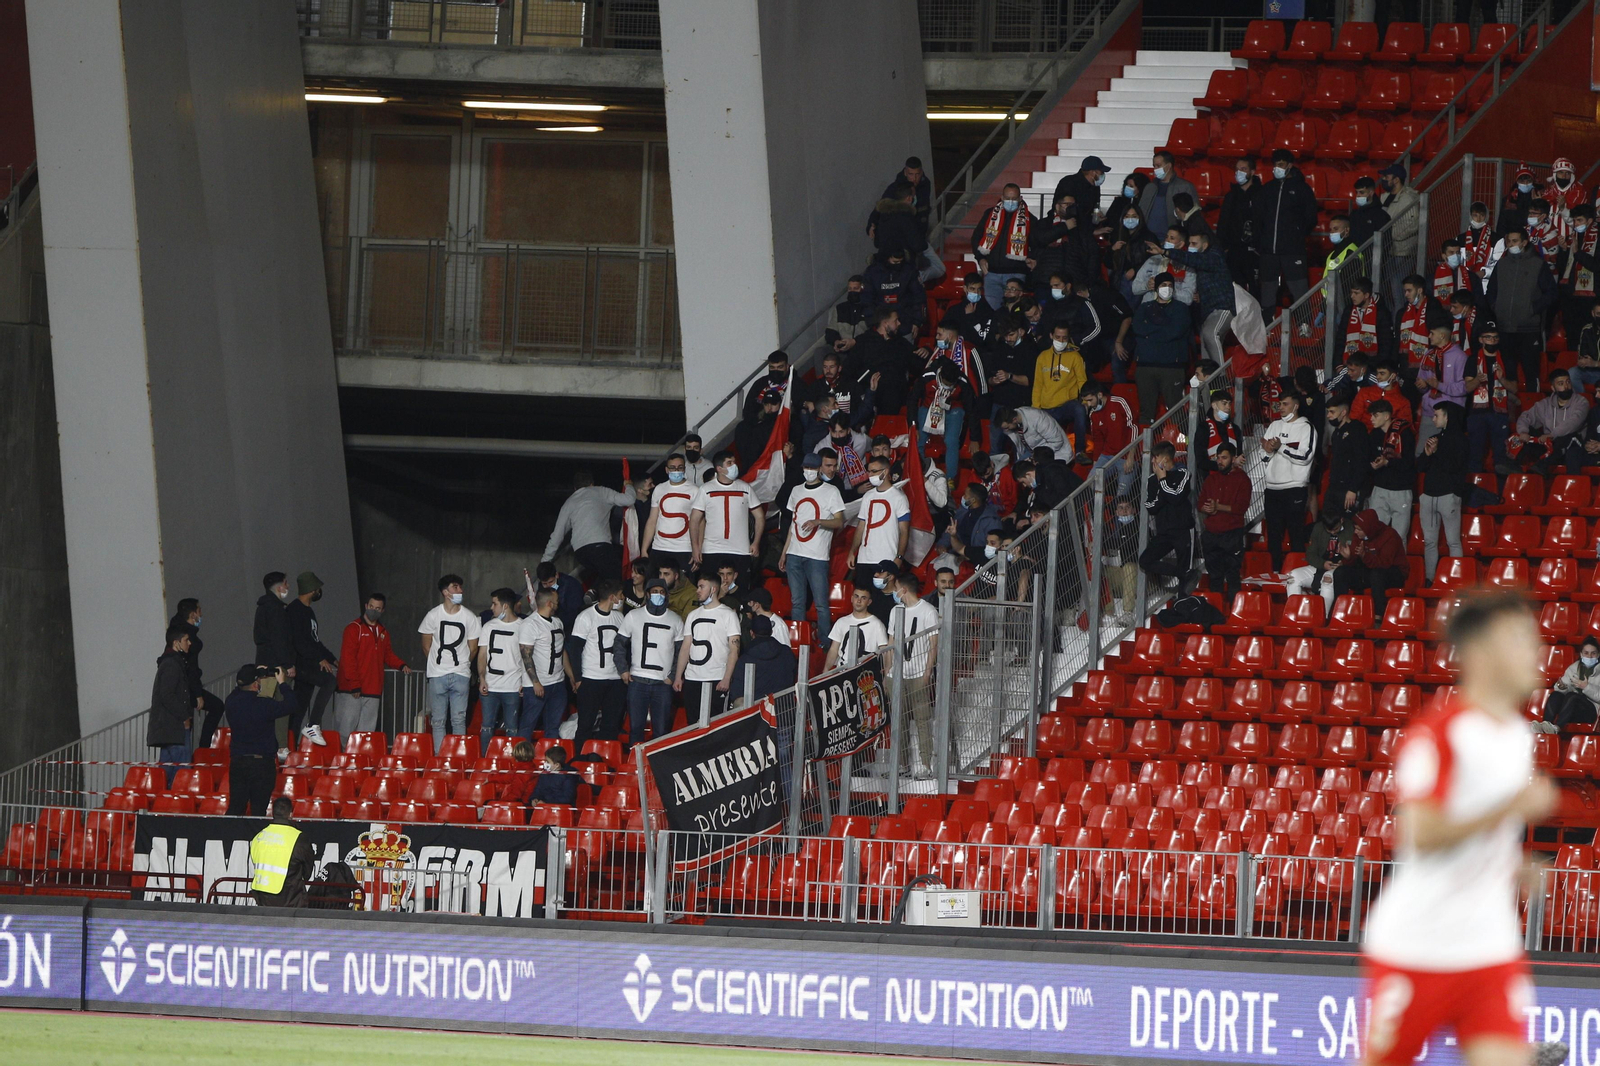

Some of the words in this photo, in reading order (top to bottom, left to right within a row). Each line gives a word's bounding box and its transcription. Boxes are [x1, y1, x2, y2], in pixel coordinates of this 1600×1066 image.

[818, 680, 857, 729] APC
[672, 735, 778, 806] ALMERIA
[694, 781, 777, 849] presente
[146, 942, 330, 993] SCIENTIFFIC
[671, 968, 870, 1021] SCIENTIFFIC
[1130, 985, 1279, 1055] DEPORTE
